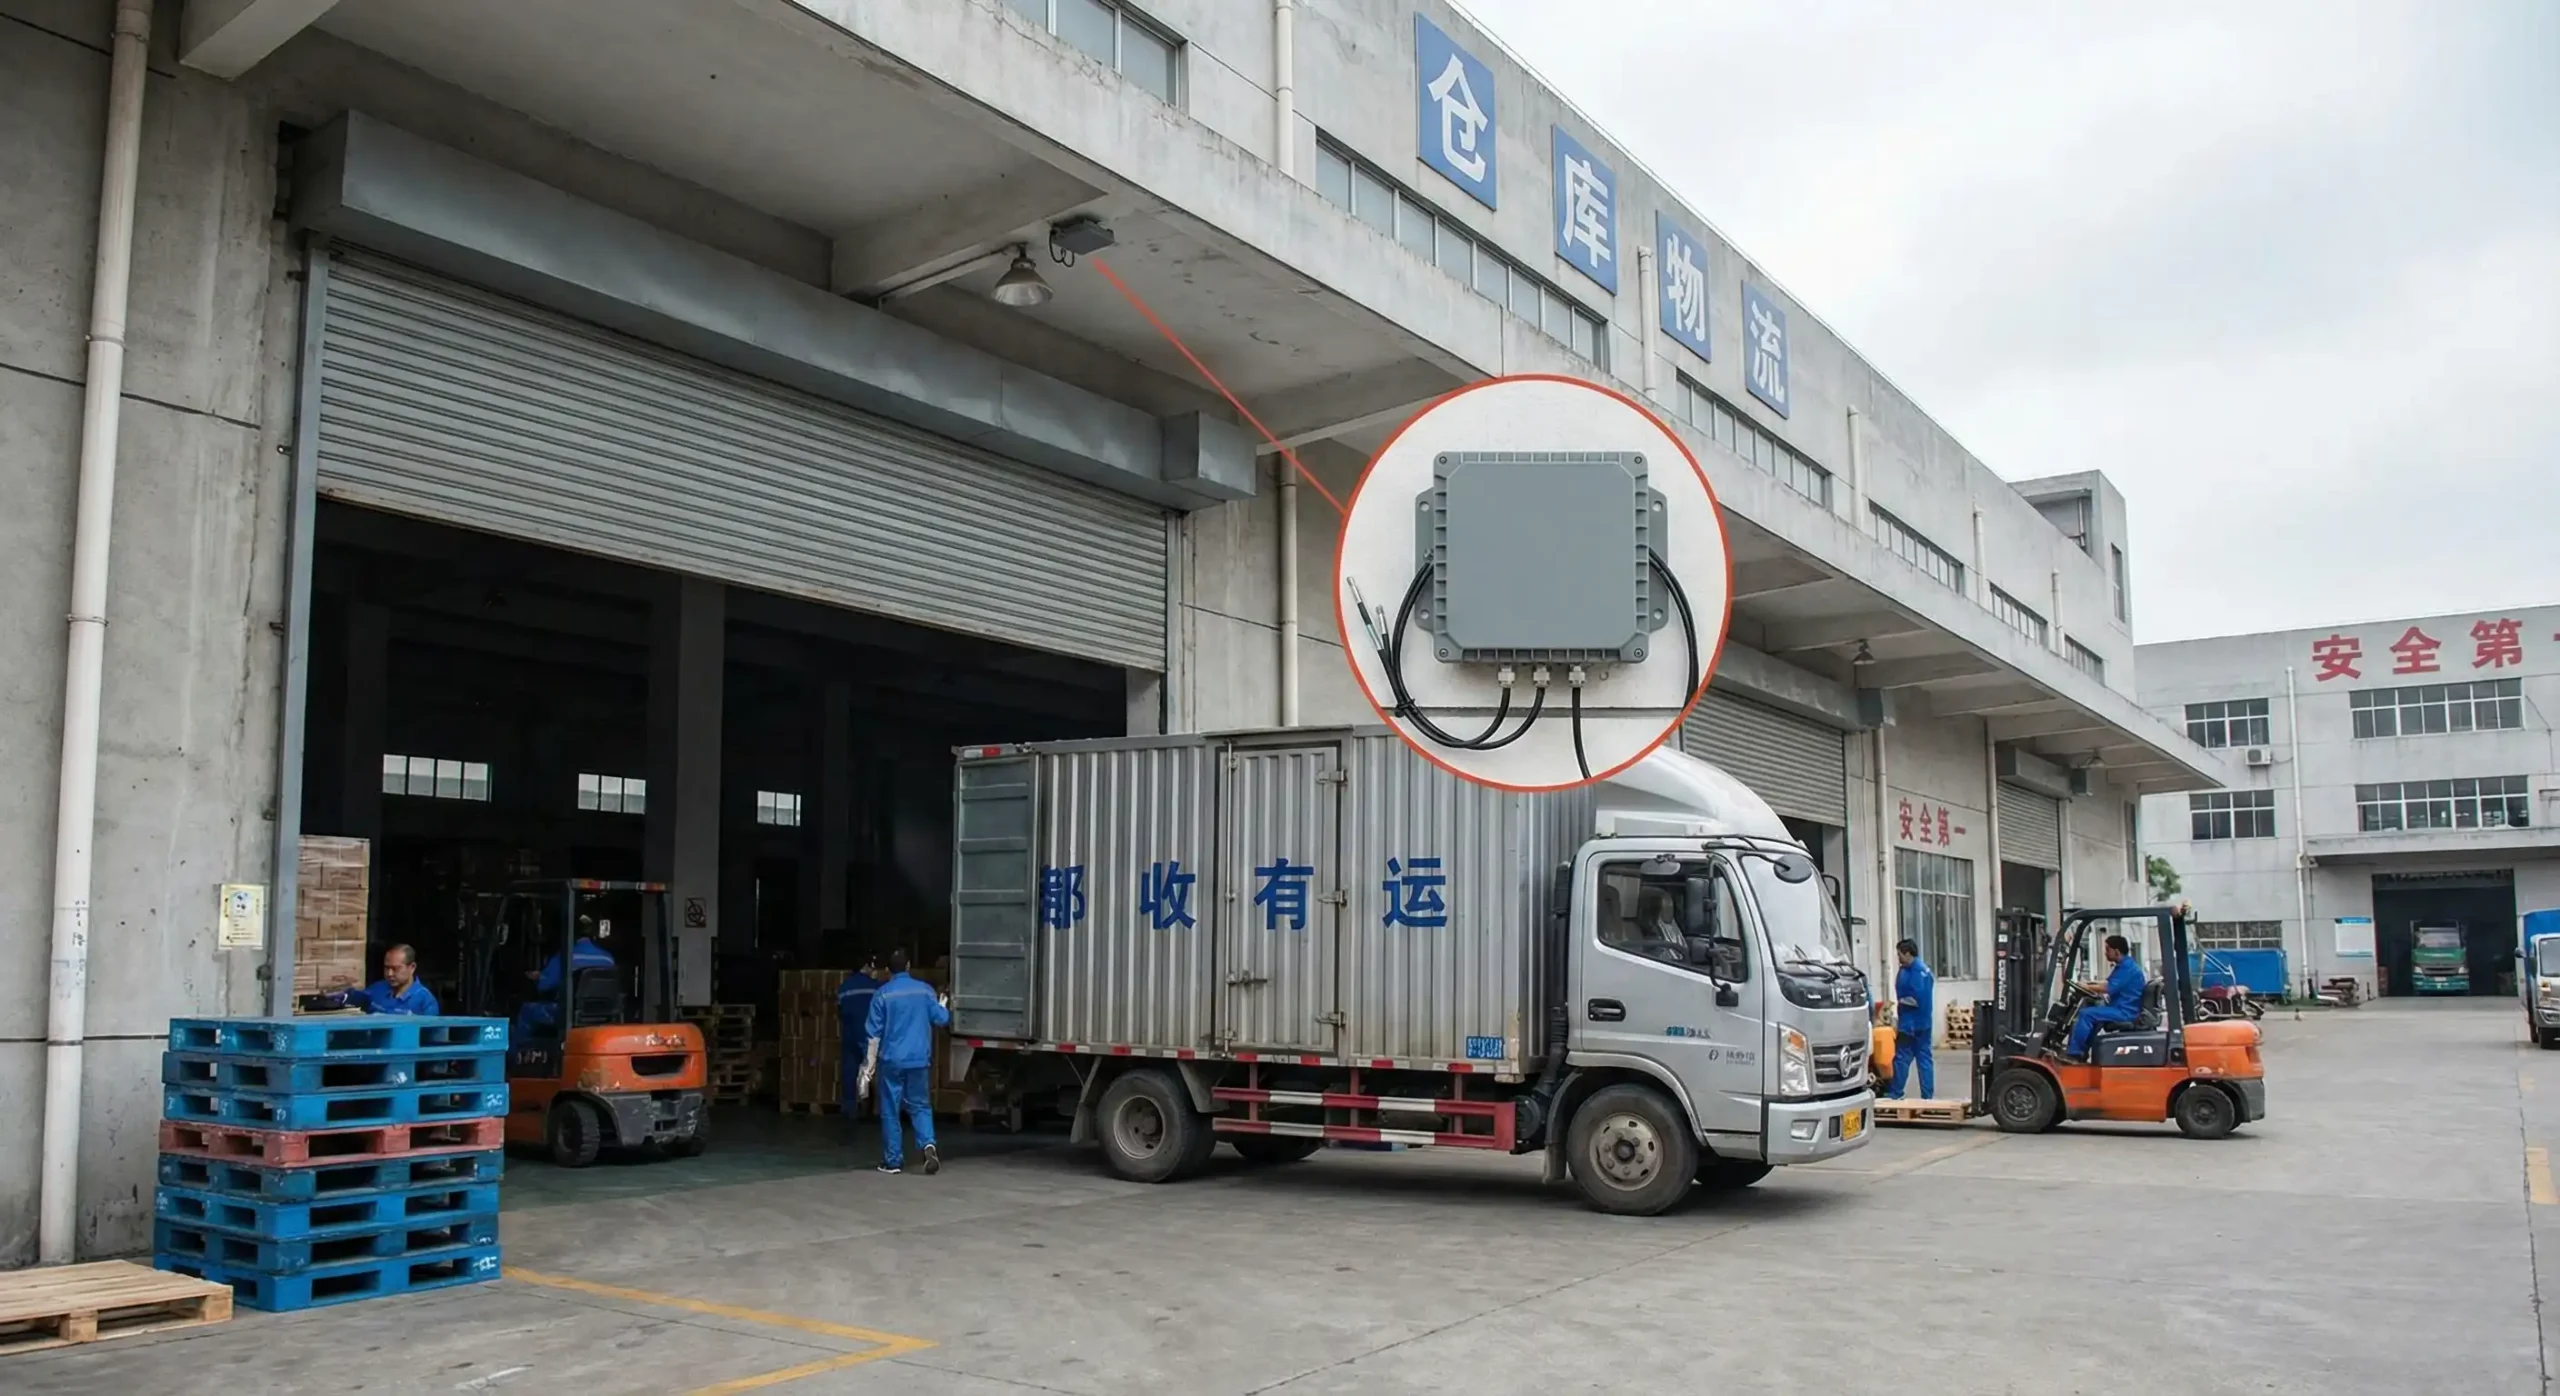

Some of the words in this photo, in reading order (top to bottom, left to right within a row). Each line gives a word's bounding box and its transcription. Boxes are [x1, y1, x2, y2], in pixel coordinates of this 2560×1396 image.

[1428, 53, 1785, 404] 仓库物流
[2312, 617, 2560, 682] 安全第
[1899, 796, 1967, 848] 安全第一
